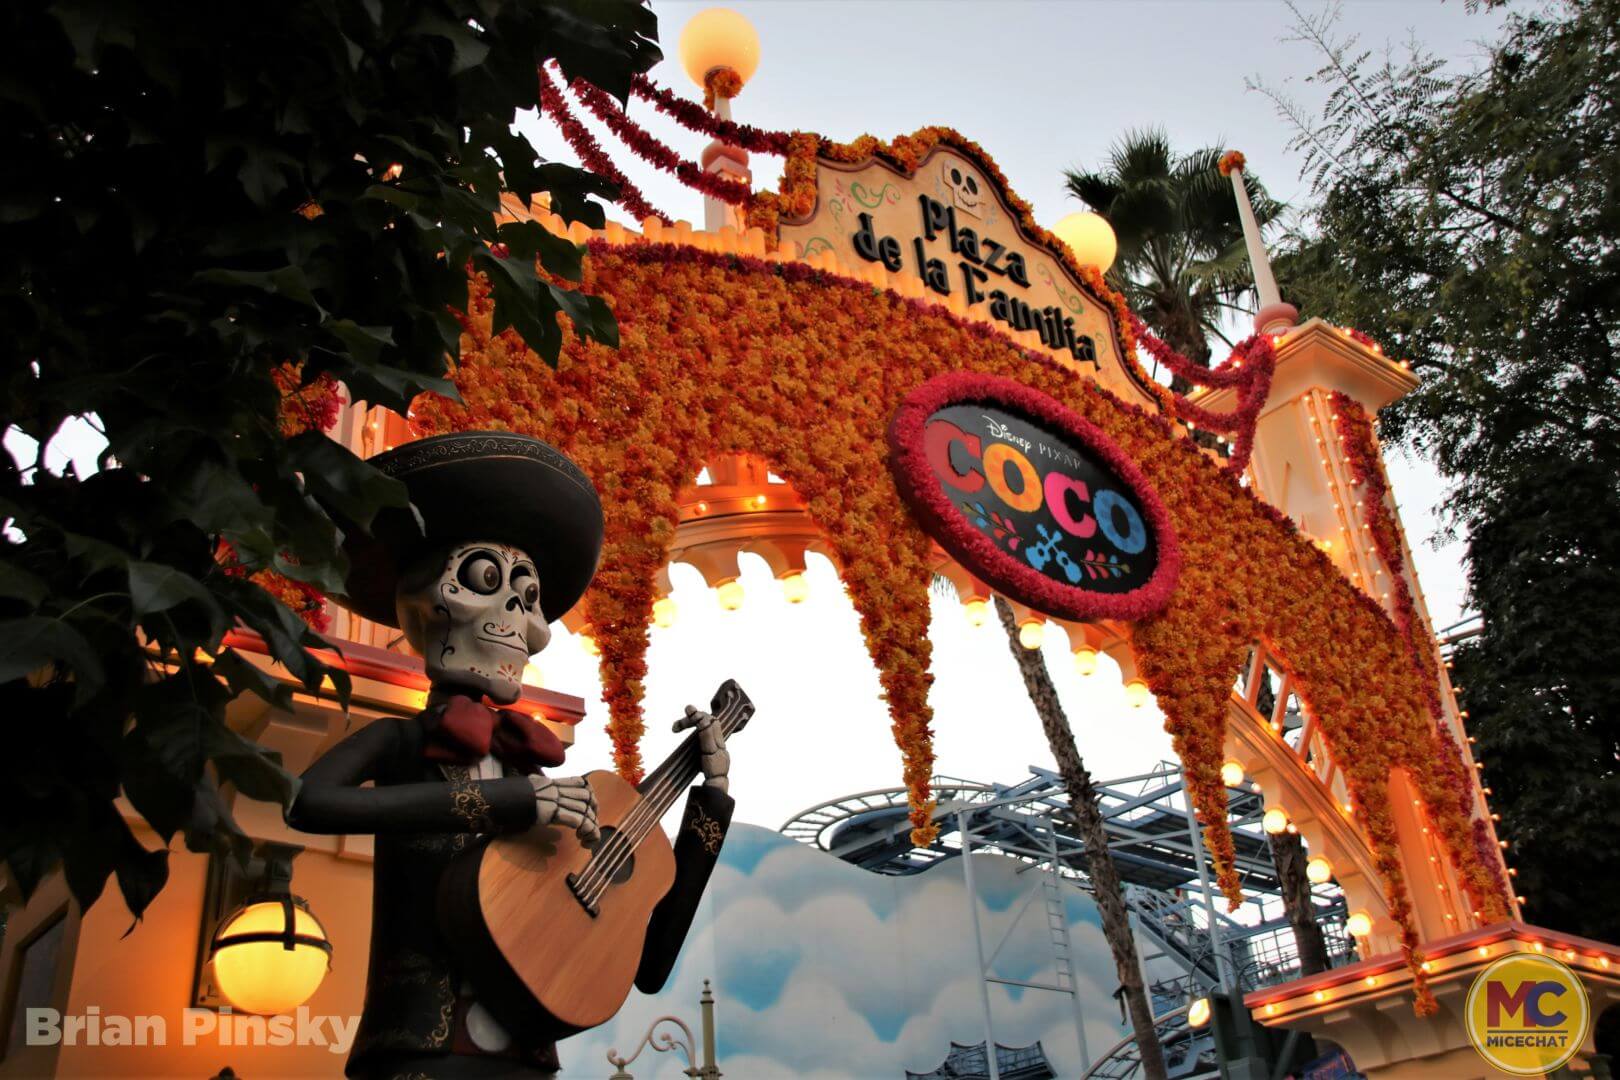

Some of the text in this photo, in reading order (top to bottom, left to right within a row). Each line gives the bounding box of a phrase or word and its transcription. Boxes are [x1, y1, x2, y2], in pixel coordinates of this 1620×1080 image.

[917, 194, 1031, 288] Plaza
[852, 212, 1102, 371] de la Familia
[982, 414, 1081, 470] Disney PIXAR
